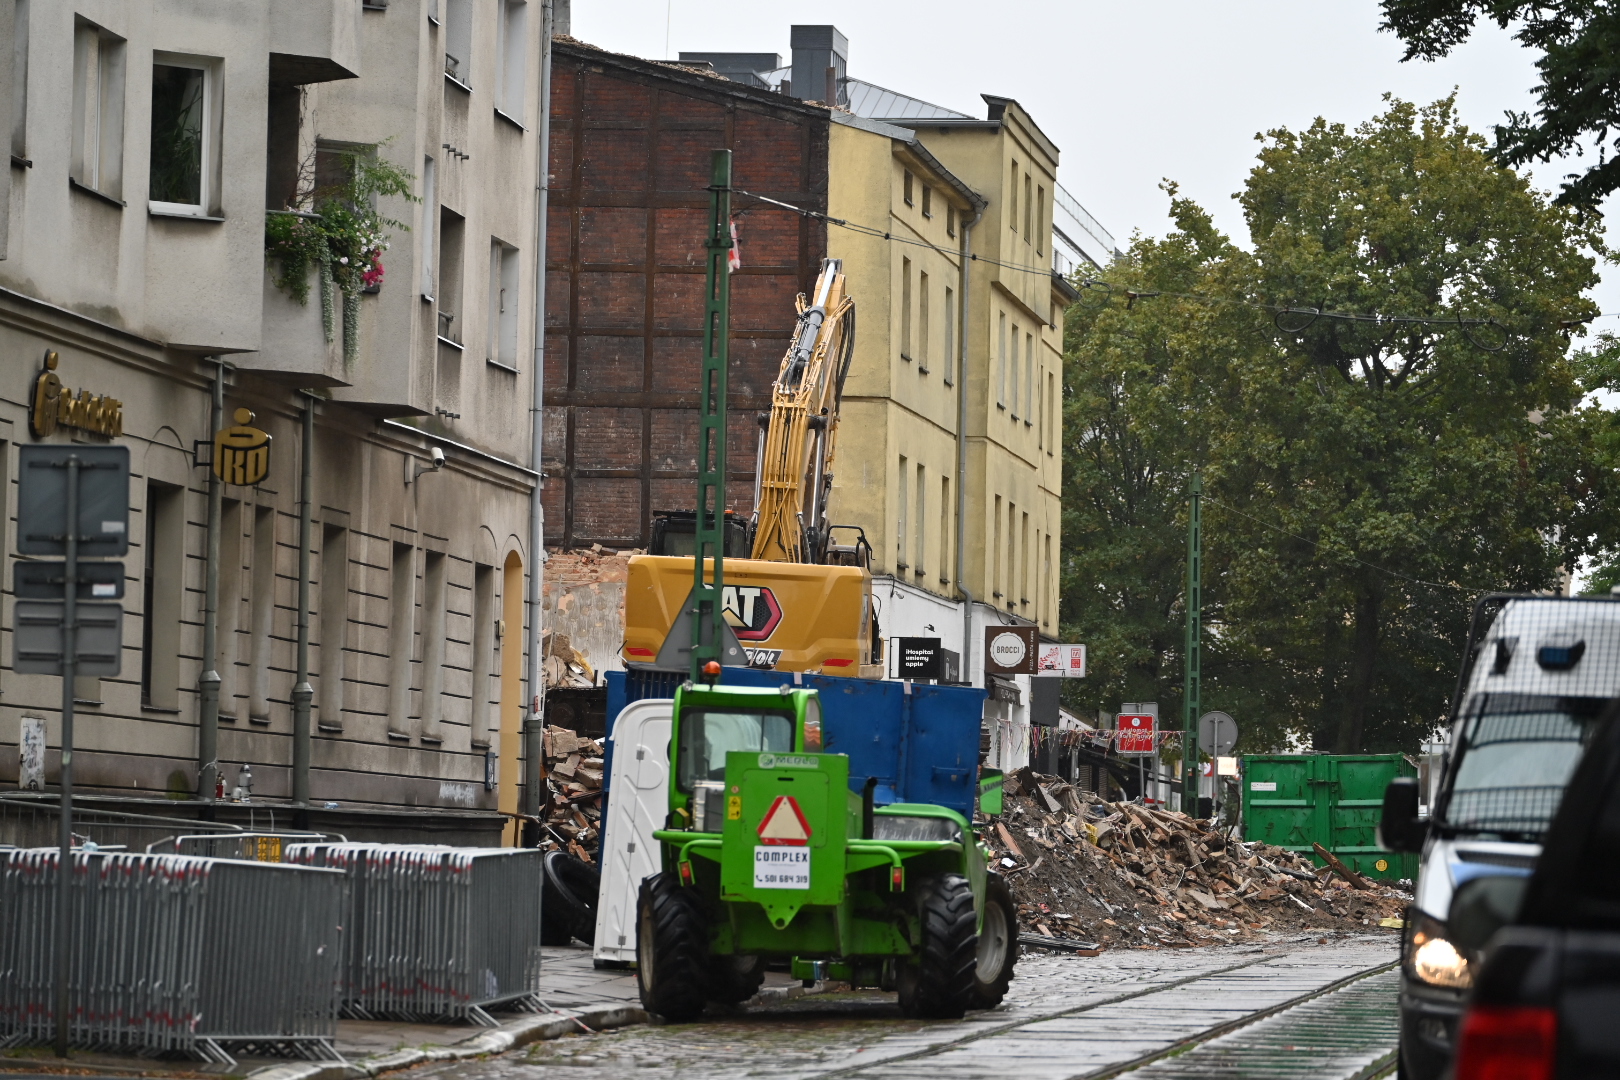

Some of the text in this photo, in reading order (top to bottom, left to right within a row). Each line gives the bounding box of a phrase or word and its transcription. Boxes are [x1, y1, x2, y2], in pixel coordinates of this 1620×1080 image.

[905, 648, 934, 656] iHospital
[996, 646, 1020, 654] BROCCI
[776, 756, 819, 765] MERLO
[756, 851, 808, 863] COMPLEX
[764, 874, 808, 883] 501 684 319
